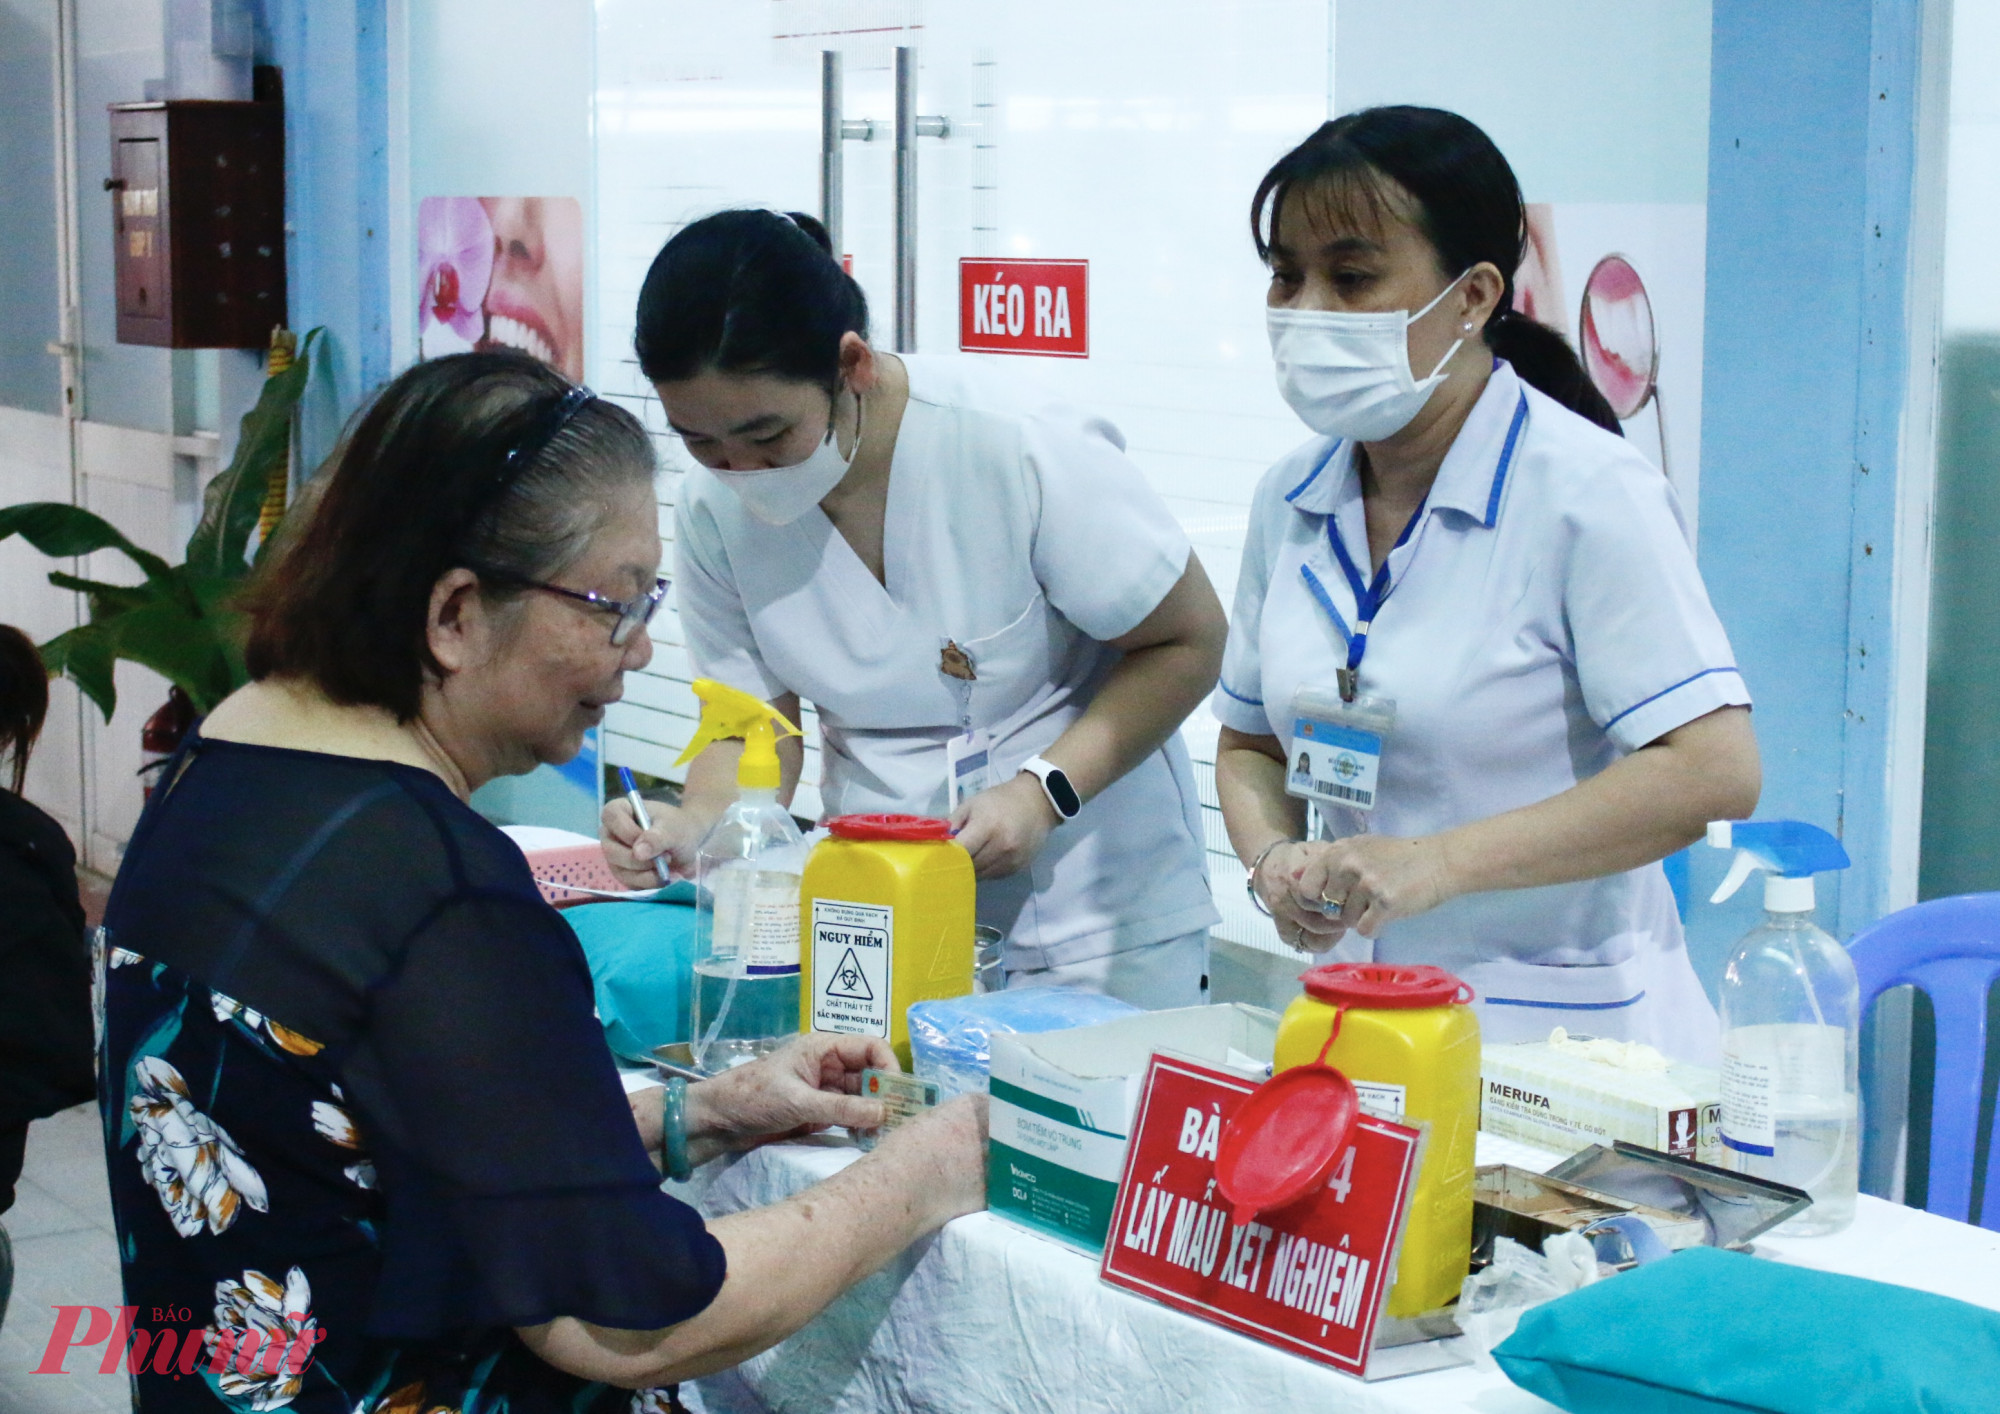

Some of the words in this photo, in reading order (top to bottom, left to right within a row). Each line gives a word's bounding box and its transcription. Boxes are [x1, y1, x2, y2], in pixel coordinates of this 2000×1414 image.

[973, 271, 1025, 337] KÉO
[1034, 285, 1072, 338] RA
[819, 930, 851, 944] NGUY
[854, 930, 883, 948] HIỂM
[817, 1008, 830, 1018] SẮC
[831, 1013, 850, 1022] NHỌN
[851, 1015, 869, 1024] NGUY
[870, 1018, 883, 1026] HẠI
[826, 999, 843, 1008] CHẤT
[844, 1001, 858, 1010] THẢI
[865, 1003, 873, 1012] TẾ
[1489, 1082, 1551, 1110] MERUFA
[1521, 1105, 1532, 1114] TRA
[1548, 1113, 1568, 1126] TRONG
[1178, 1103, 1230, 1162] BÀ
[1328, 1146, 1356, 1203] 4
[1123, 1165, 1174, 1257] LẤY
[1166, 1178, 1227, 1277] MẪU
[1266, 1232, 1370, 1338] NGHIỆM
